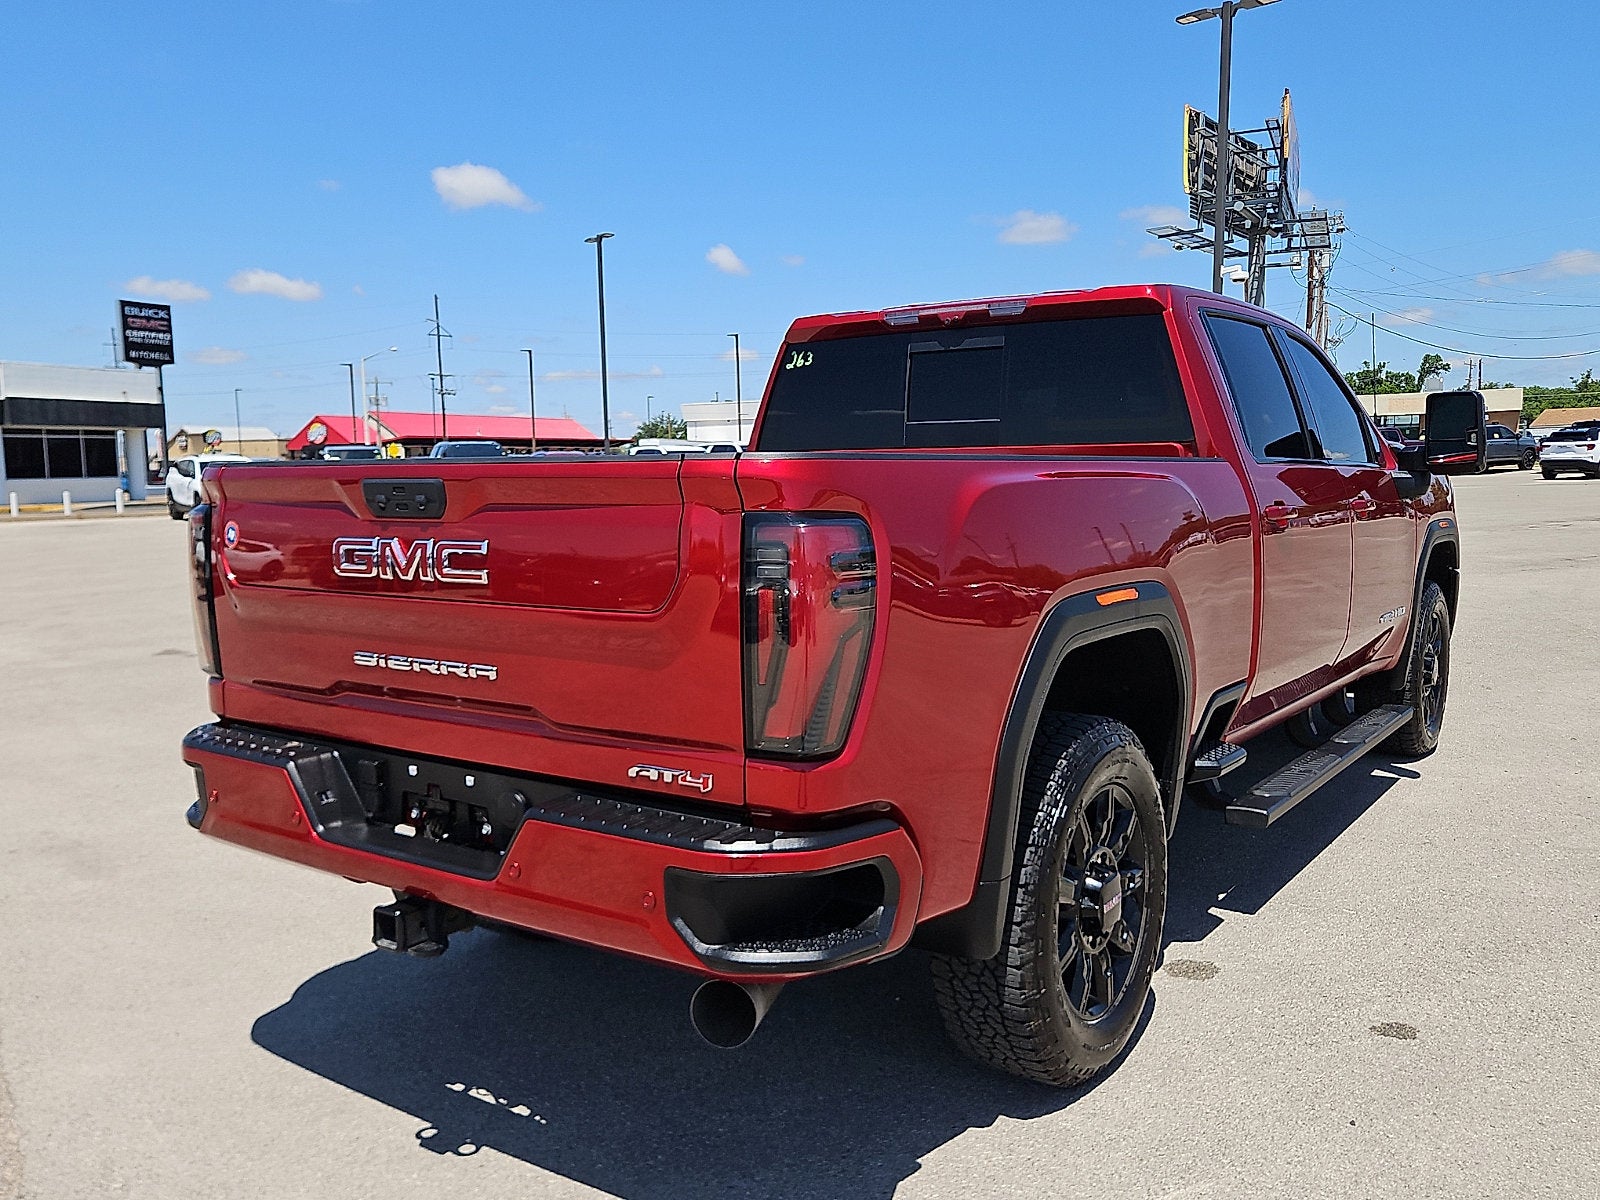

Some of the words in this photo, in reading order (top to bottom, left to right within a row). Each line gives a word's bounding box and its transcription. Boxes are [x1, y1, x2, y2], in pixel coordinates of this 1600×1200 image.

[124, 305, 170, 319] BUICK
[127, 317, 169, 330] GMC
[785, 350, 814, 370] 263
[332, 536, 490, 585] GMC
[352, 650, 498, 681] SIERRA
[627, 763, 714, 793] AT4
